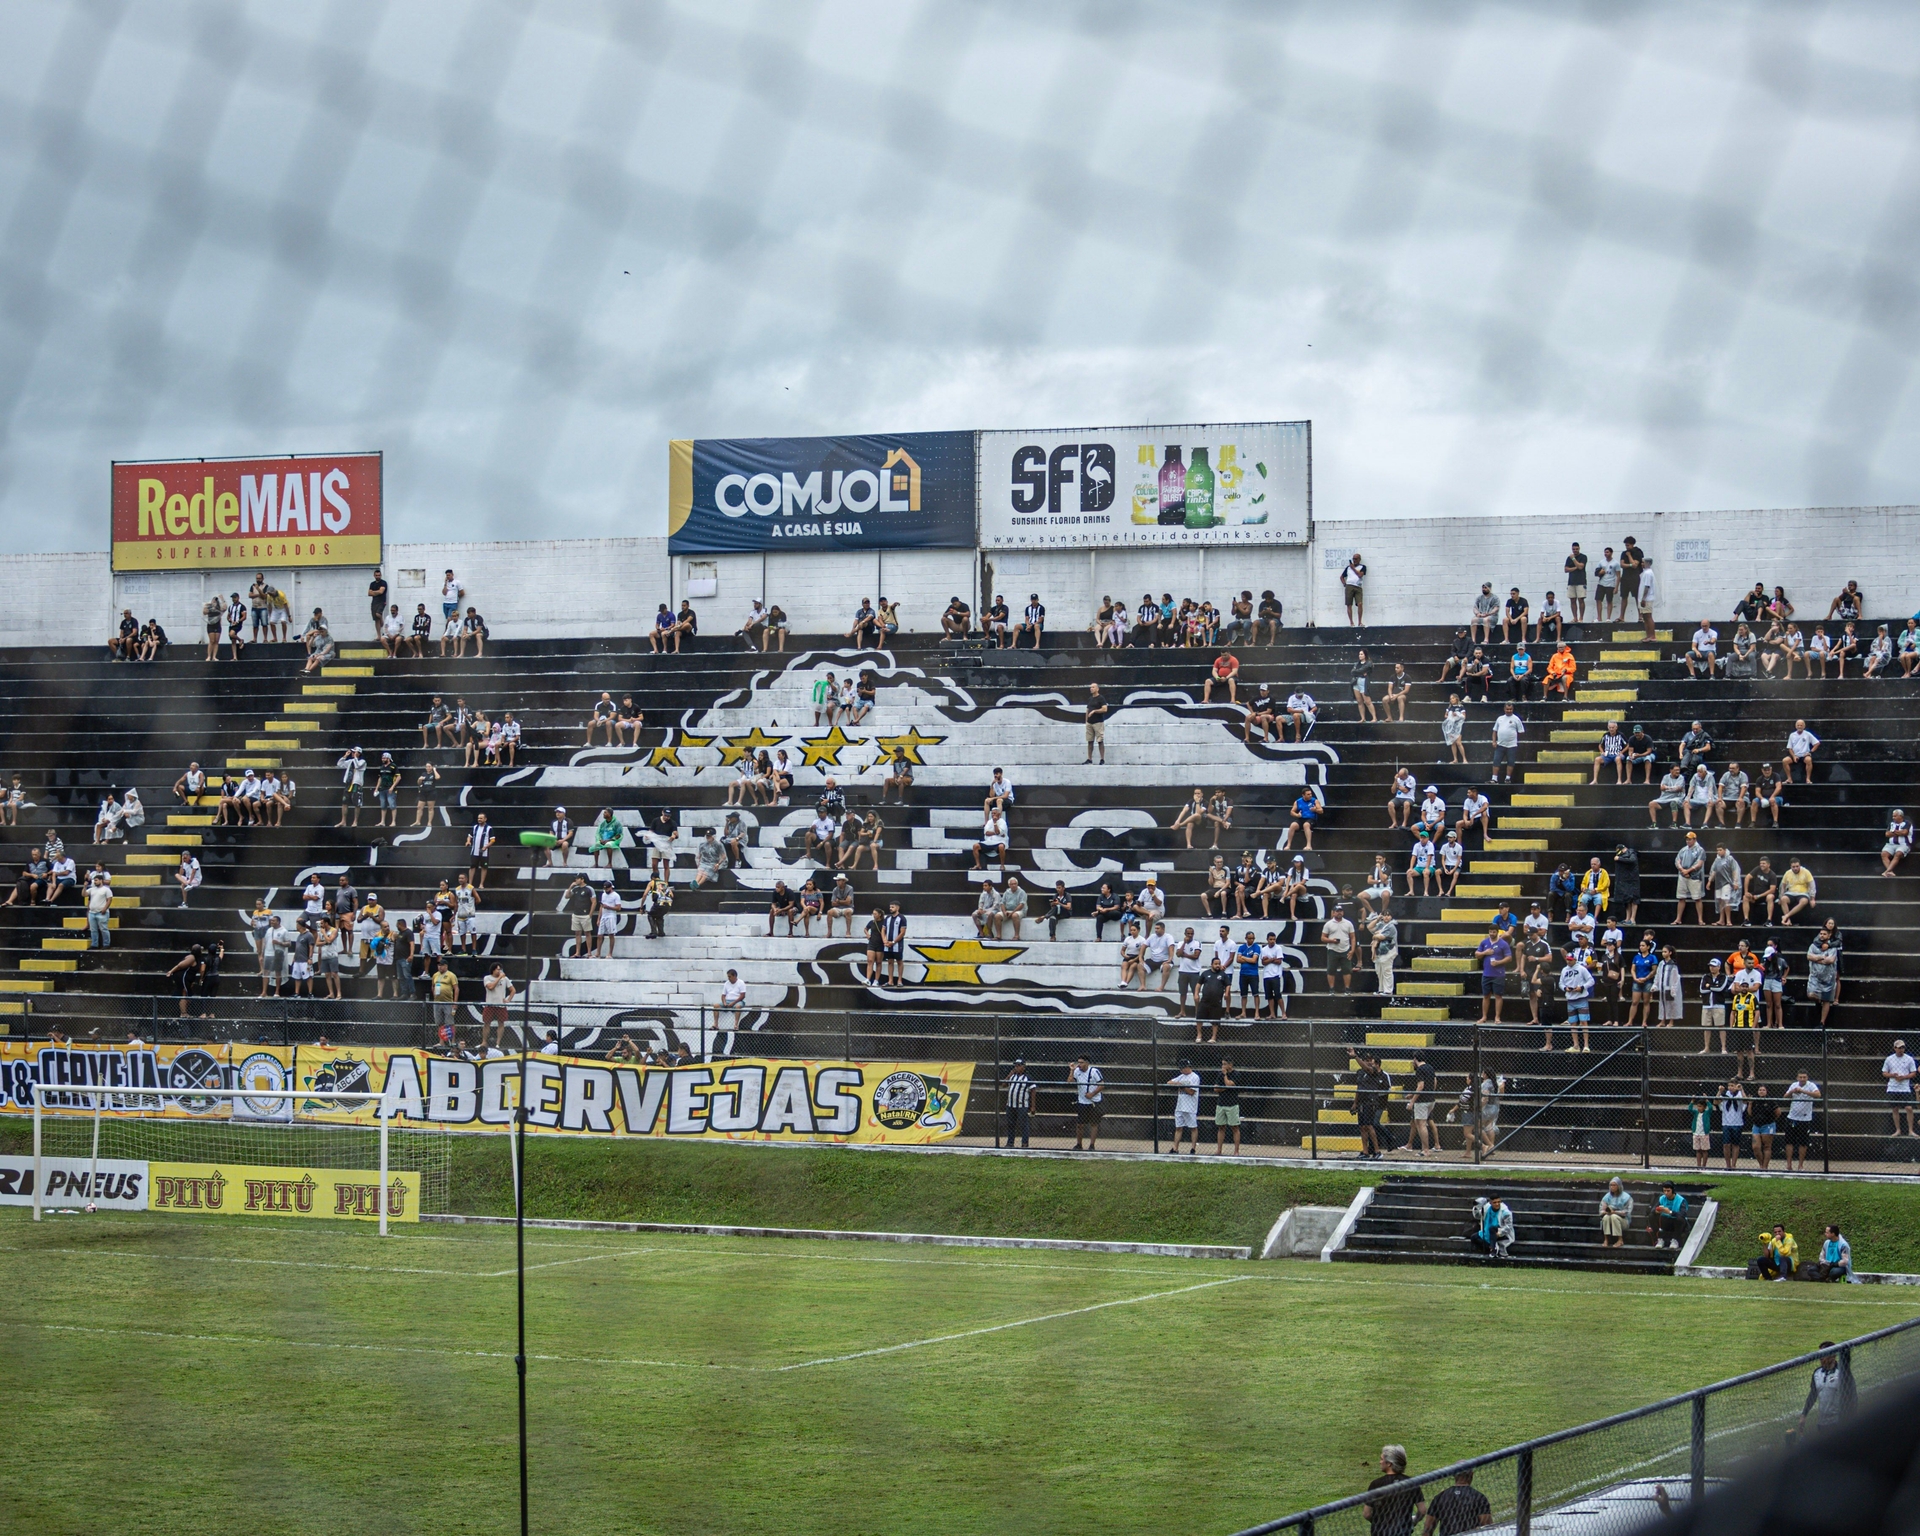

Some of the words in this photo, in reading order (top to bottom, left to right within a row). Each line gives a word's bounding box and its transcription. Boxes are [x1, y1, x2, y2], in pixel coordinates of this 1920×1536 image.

[714, 469, 909, 517] COMJOL
[1011, 443, 1115, 513] SFD
[771, 524, 783, 538] A
[784, 523, 821, 537] CASA
[822, 520, 832, 536] É
[834, 522, 863, 536] SUA
[1011, 517, 1047, 526] SUNSHINE
[1050, 516, 1081, 525] FLORIDA
[1083, 515, 1110, 524] DRINKS
[157, 543, 330, 560] SUPERMERCADOS
[1676, 541, 1699, 550] SETOR
[337, 1077, 352, 1091] ABC
[376, 1055, 863, 1134] ABCERVEJAS
[45, 1170, 143, 1200] PNEUS
[155, 1170, 225, 1209] PITÚ
[244, 1173, 316, 1213] PITÚ
